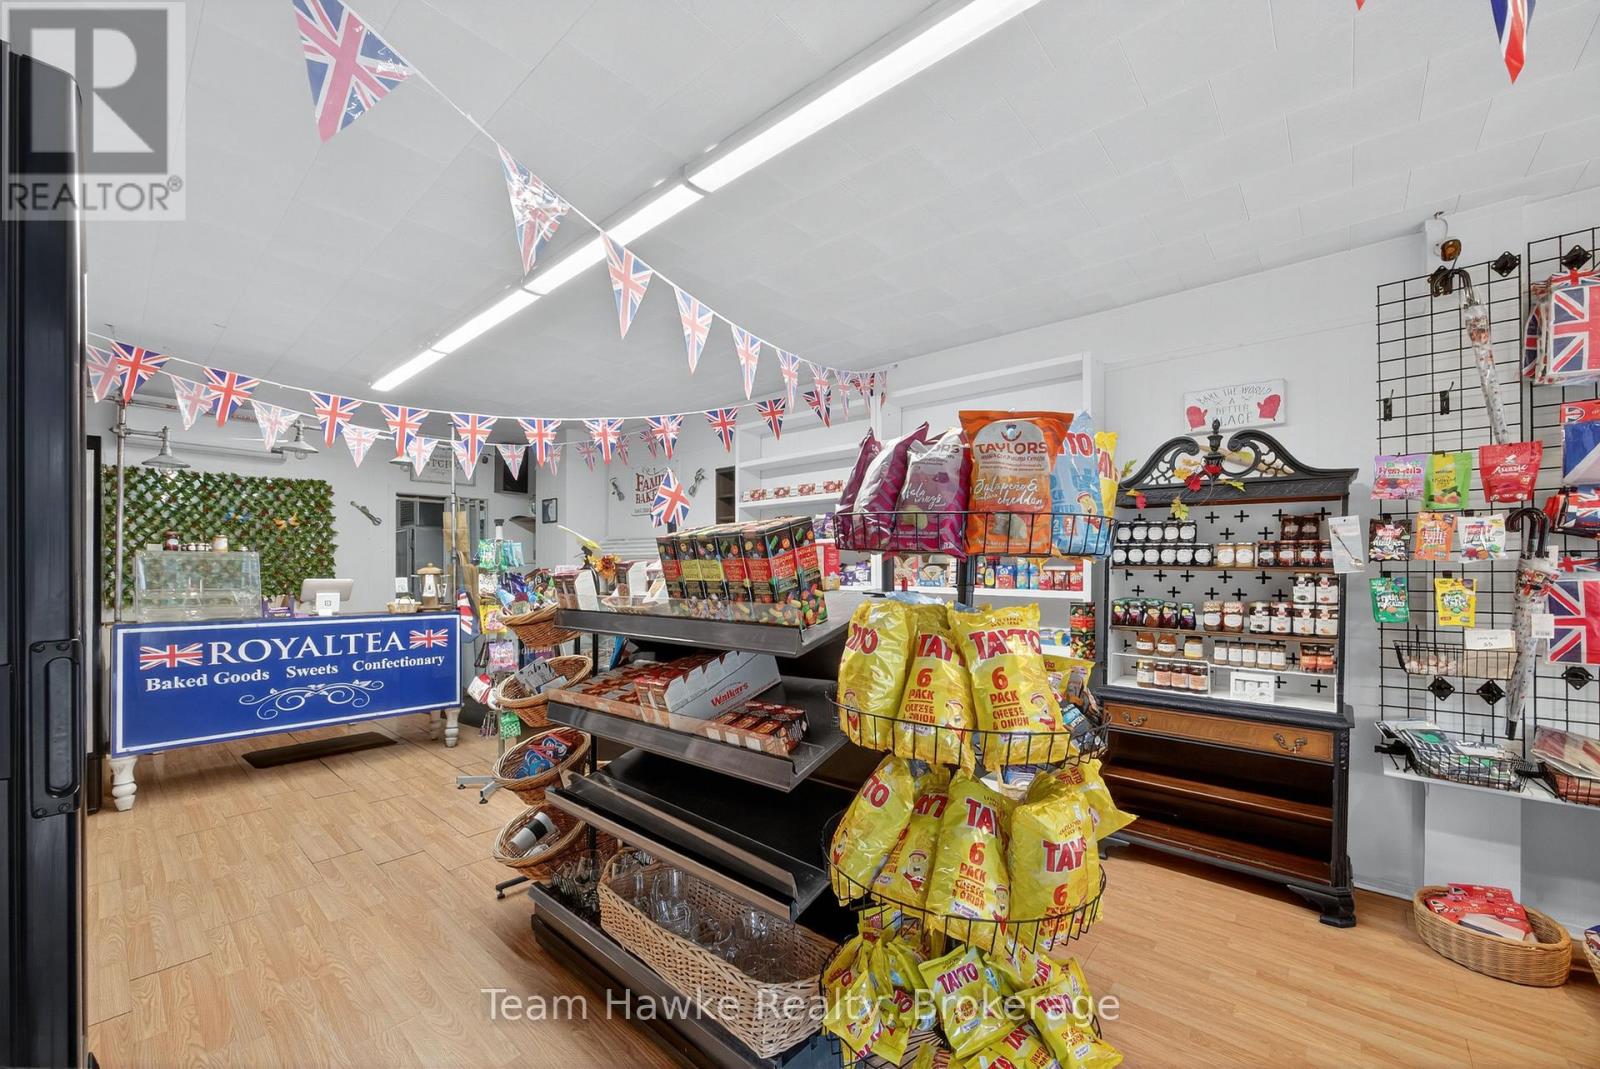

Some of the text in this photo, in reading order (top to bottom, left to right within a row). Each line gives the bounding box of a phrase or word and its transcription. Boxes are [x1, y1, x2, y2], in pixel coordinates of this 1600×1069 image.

[975, 442, 1048, 455] TAYLORS
[208, 631, 406, 666] ROYALTEA
[968, 628, 1042, 660] TAYTO
[145, 655, 445, 692] Baked Goods Sweets Confectionary
[916, 667, 934, 688] 6
[991, 666, 1009, 690] 6
[711, 682, 749, 706] Walkers
[907, 688, 935, 700] PACK
[989, 690, 1020, 705] PACK
[992, 706, 1025, 720] CHEESE
[1000, 717, 1030, 730] ONION
[969, 841, 986, 866] 6
[960, 862, 987, 882] PACK
[1053, 883, 1068, 906] 6
